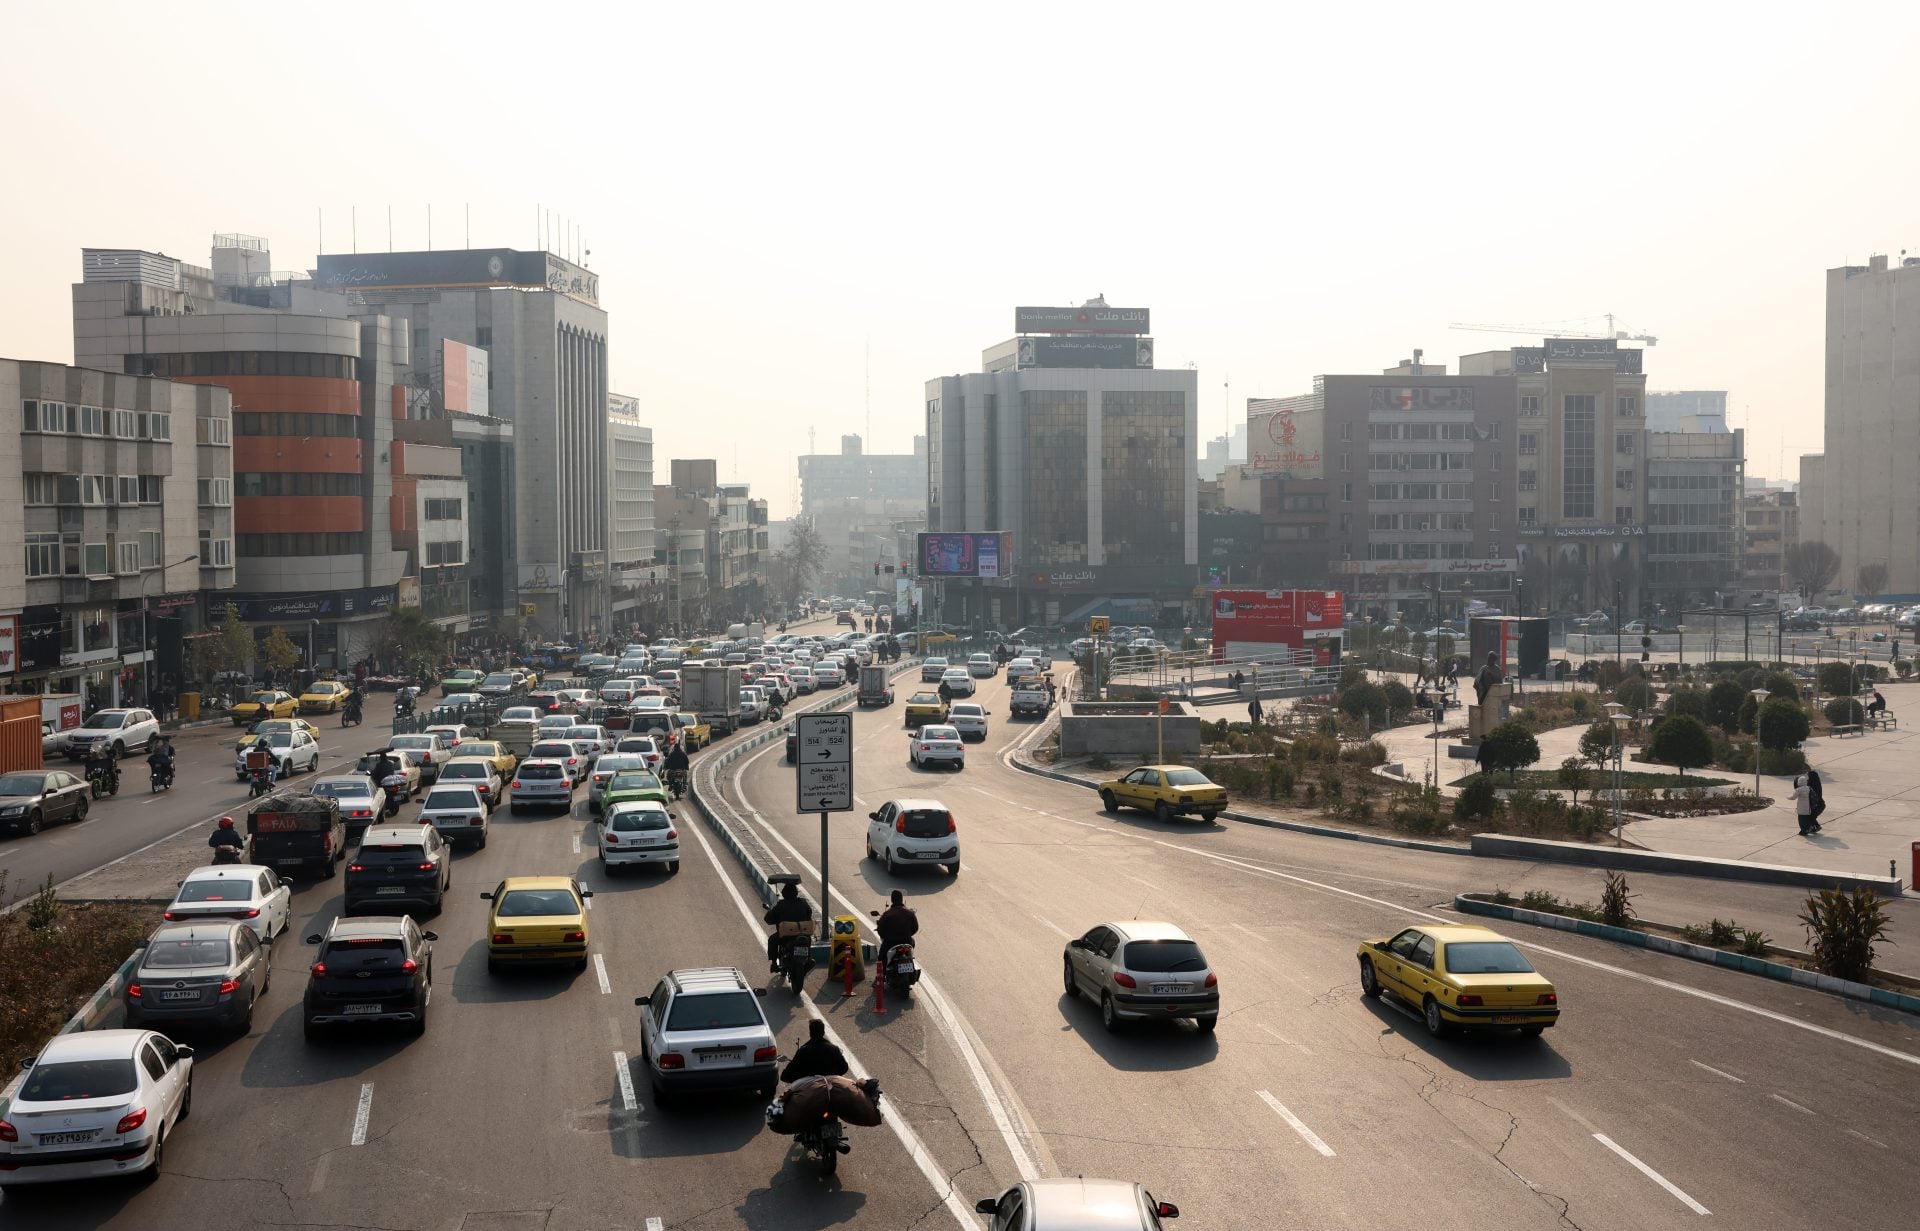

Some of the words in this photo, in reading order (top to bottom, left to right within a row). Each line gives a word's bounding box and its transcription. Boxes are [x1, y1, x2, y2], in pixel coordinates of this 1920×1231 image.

[1020, 310, 1043, 321] bank
[1045, 310, 1072, 320] mellat
[1096, 311, 1119, 321] ملت
[1121, 310, 1145, 323] بانک
[1098, 343, 1122, 351] مدیریت
[1549, 342, 1576, 357] ژیوا
[1579, 342, 1615, 357] مانتو
[1283, 450, 1320, 464] فولاد
[1051, 572, 1073, 580] ملت
[1074, 571, 1096, 583] بانک
[819, 726, 838, 735] کشاورز
[810, 767, 823, 775] مفتح
